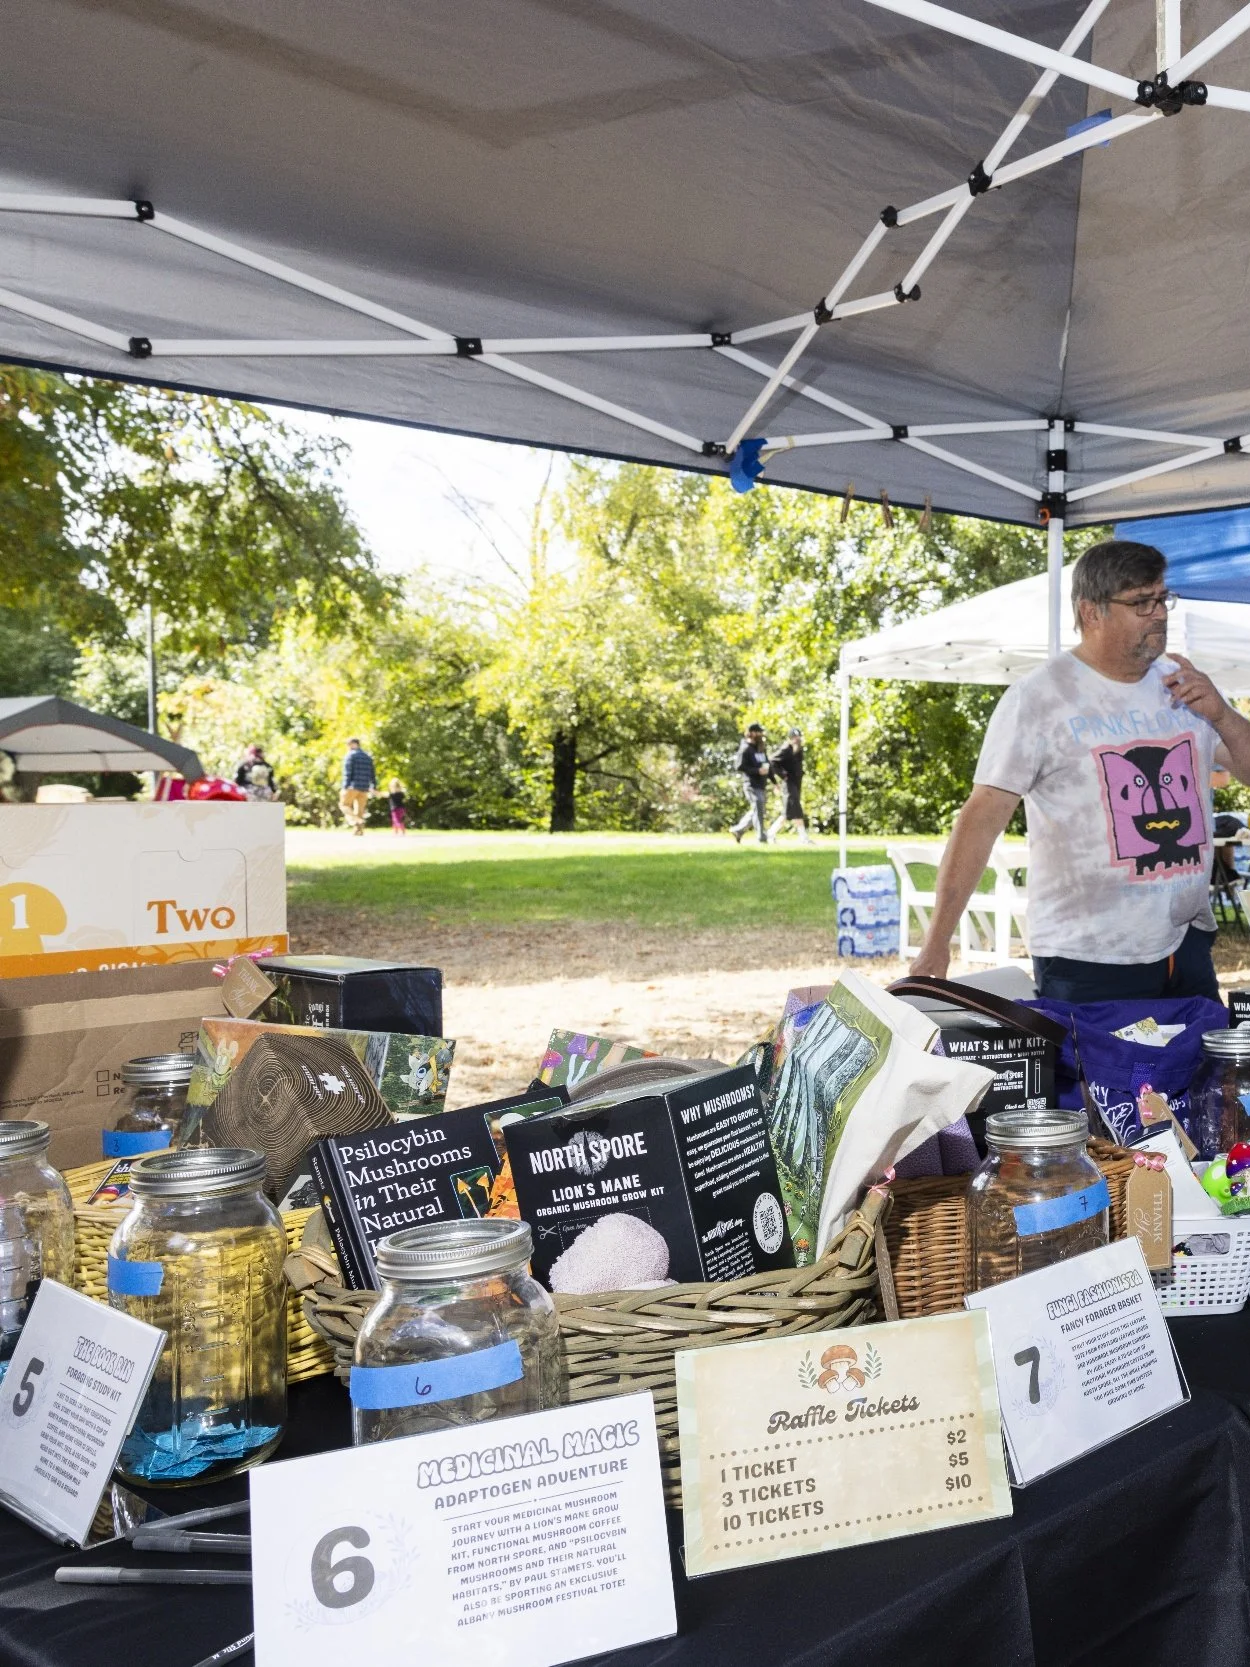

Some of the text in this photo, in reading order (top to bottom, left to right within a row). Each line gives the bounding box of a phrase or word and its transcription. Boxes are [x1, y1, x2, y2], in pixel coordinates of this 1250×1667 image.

[11, 894, 30, 929] 1
[949, 1037, 1046, 1052] WHAT'S IN MY KIT?
[680, 1105, 701, 1124] WHY
[703, 1084, 755, 1116] MUSHROOMS?
[716, 1119, 730, 1131] EASY
[730, 1115, 737, 1125] TO
[338, 1128, 447, 1165] Psilocybin
[529, 1132, 647, 1174] NORTH SPORE
[694, 1154, 711, 1166] enjoying
[710, 1139, 740, 1158] DELICIOUS
[706, 1160, 727, 1173] Mushrooms
[743, 1140, 765, 1156] HEALTHY
[312, 1157, 325, 1190] Stamets
[346, 1146, 472, 1188] Mushrooms
[355, 1178, 437, 1210] in Their
[537, 1187, 665, 1217] ORGANIC MUSHROOM GROW KIT
[552, 1174, 641, 1202] LION'S MANE
[1079, 1195, 1088, 1211] 7
[361, 1196, 444, 1234] Natural
[1153, 1191, 1163, 1243] THANK
[335, 1228, 350, 1268] Psilocybin
[1047, 1268, 1143, 1320] FUNGI FASHIONISTA
[1060, 1294, 1143, 1334] FANCY FORAGER BASKET
[74, 1336, 135, 1383] THE BOOK BIN
[1014, 1346, 1040, 1404] 7
[13, 1357, 44, 1417] 5
[90, 1381, 111, 1396] STUDY
[110, 1388, 122, 1402] KIT
[415, 1377, 432, 1395] 6
[767, 1395, 920, 1434] Raffle Tickets
[417, 1420, 640, 1489] MEDICINAL MAGIC
[732, 1457, 797, 1482] TICKET
[947, 1430, 967, 1445] $2
[434, 1459, 628, 1510] ADAPTOGEN ADVENTURE
[722, 1452, 969, 1507] 3 TICKETS $5
[451, 1492, 617, 1534] START YOUR MEDICINAL MUSHROOM
[723, 1474, 972, 1531] 10 TICKETS $10
[452, 1532, 495, 1547] JOURNEY
[498, 1526, 522, 1537] WITH
[533, 1517, 562, 1529] LION'S
[565, 1511, 590, 1522] MANE
[593, 1504, 619, 1516] GROW
[472, 1538, 530, 1556] FUNCTIONAL
[532, 1524, 587, 1542] MUSHROOM
[589, 1516, 621, 1529] COFFEE
[309, 1526, 376, 1610] 6
[448, 1561, 475, 1575] FROM
[477, 1555, 510, 1567] NORTH
[549, 1542, 567, 1552] AND
[461, 1543, 617, 1585] MUSHROOMS AND THEIR NATURAL
[509, 1578, 521, 1587] BY
[525, 1572, 548, 1584] PAUL
[597, 1554, 627, 1566] YOU'LL
[458, 1580, 626, 1626] ALBANY MUSHROOM FESTIVAL TOTE!
[464, 1568, 618, 1611] ALSO BE SPORTING AN EXCLUSIVE
